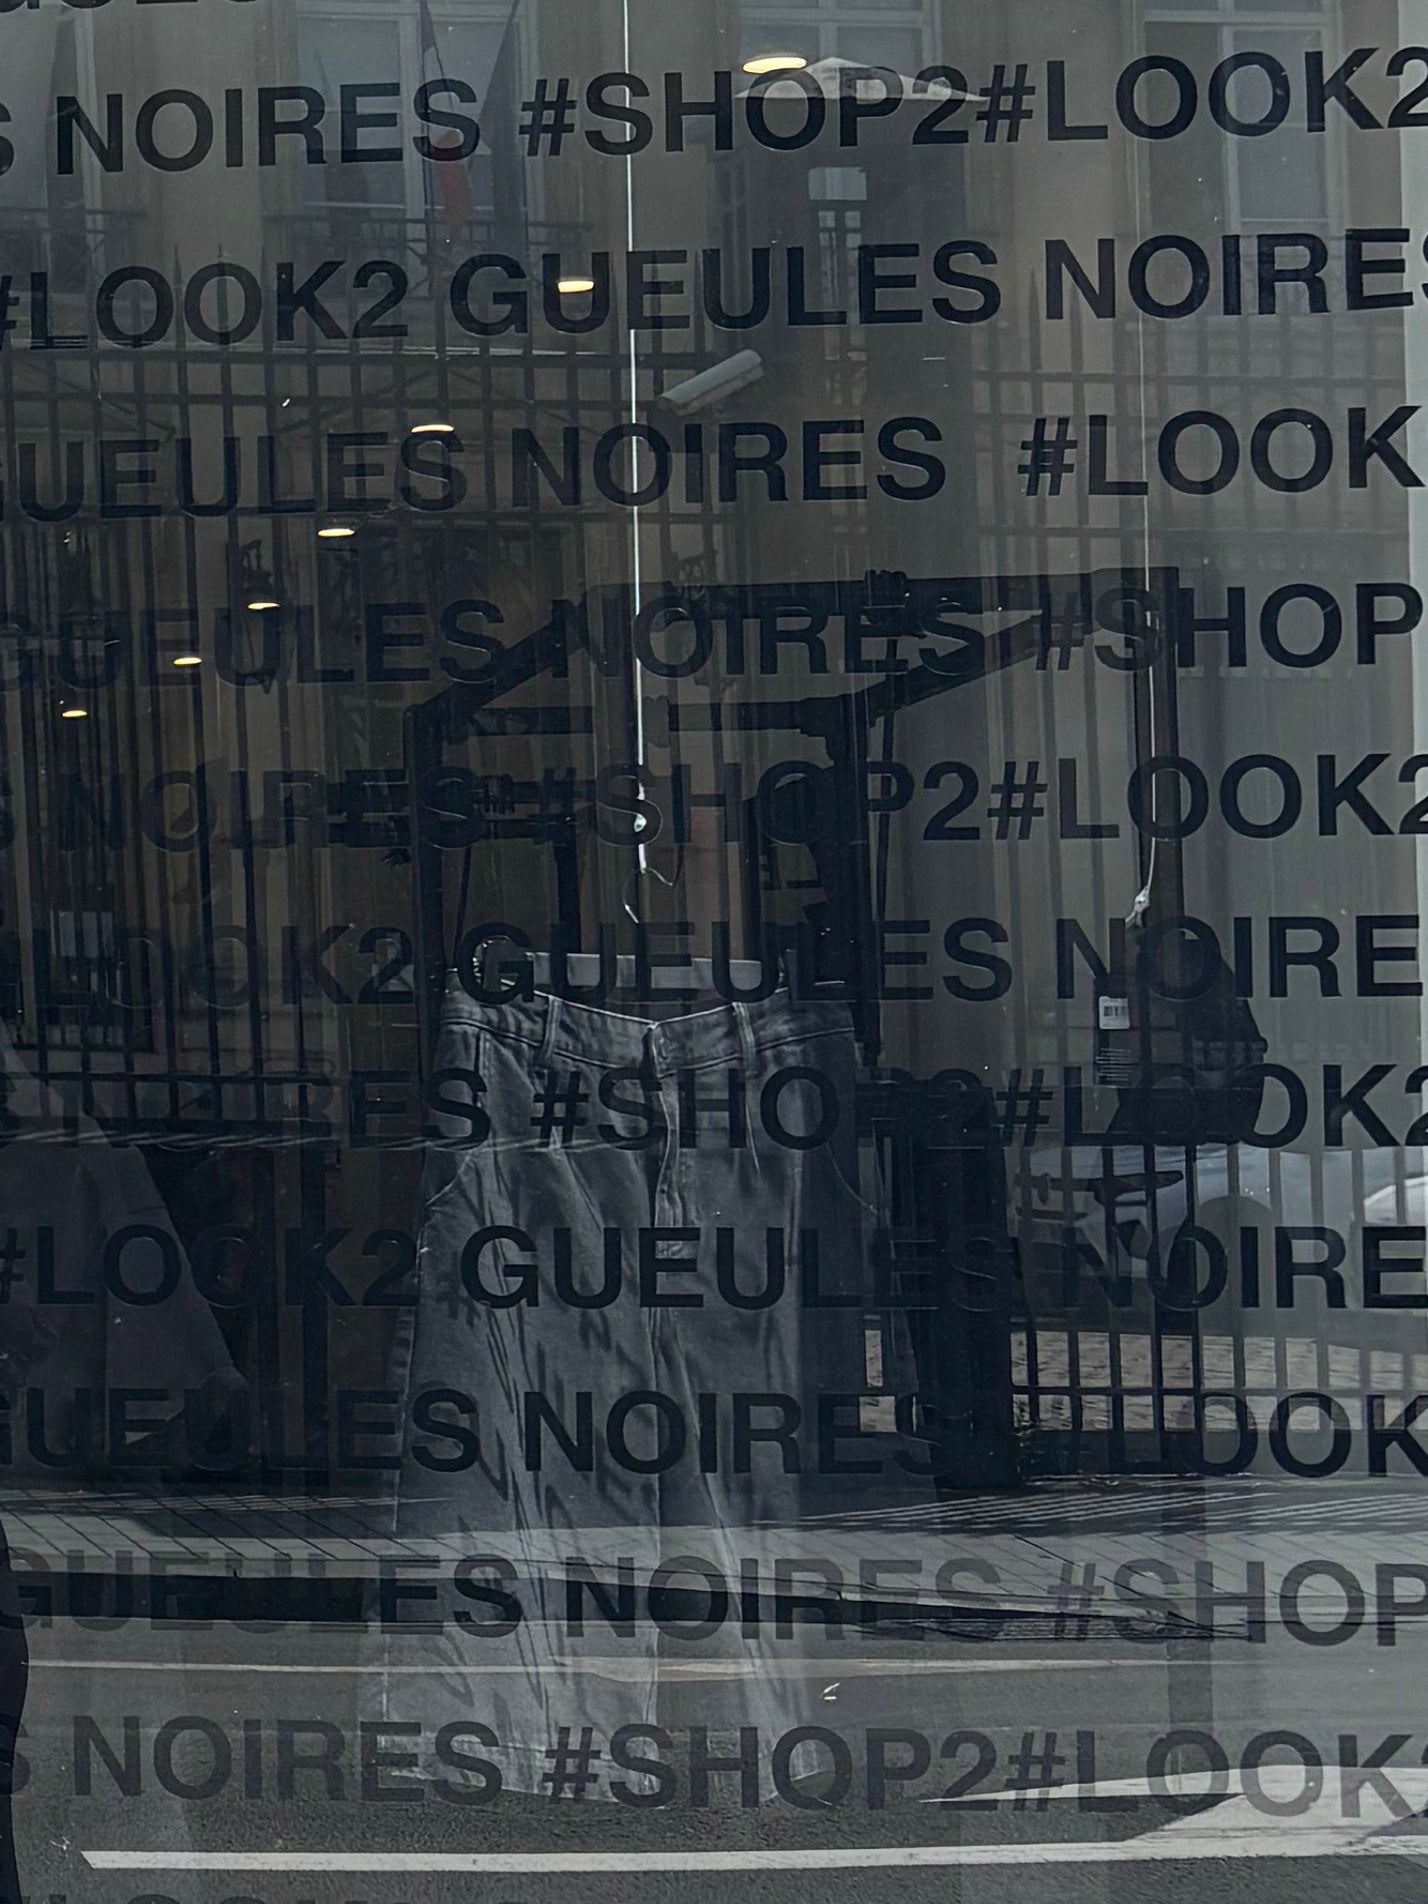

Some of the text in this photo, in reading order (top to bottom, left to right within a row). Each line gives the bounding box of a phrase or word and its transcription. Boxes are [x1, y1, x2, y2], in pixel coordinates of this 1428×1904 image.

[56, 82, 480, 176] NOIRES
[450, 240, 1001, 337] GUEULES
[511, 417, 945, 508] NOIRES
[1018, 405, 1424, 498] #LOOK
[1036, 583, 1423, 671] #SHOP
[565, 1556, 1003, 1641] NOIRES
[75, 1715, 502, 1803] NOIRES
